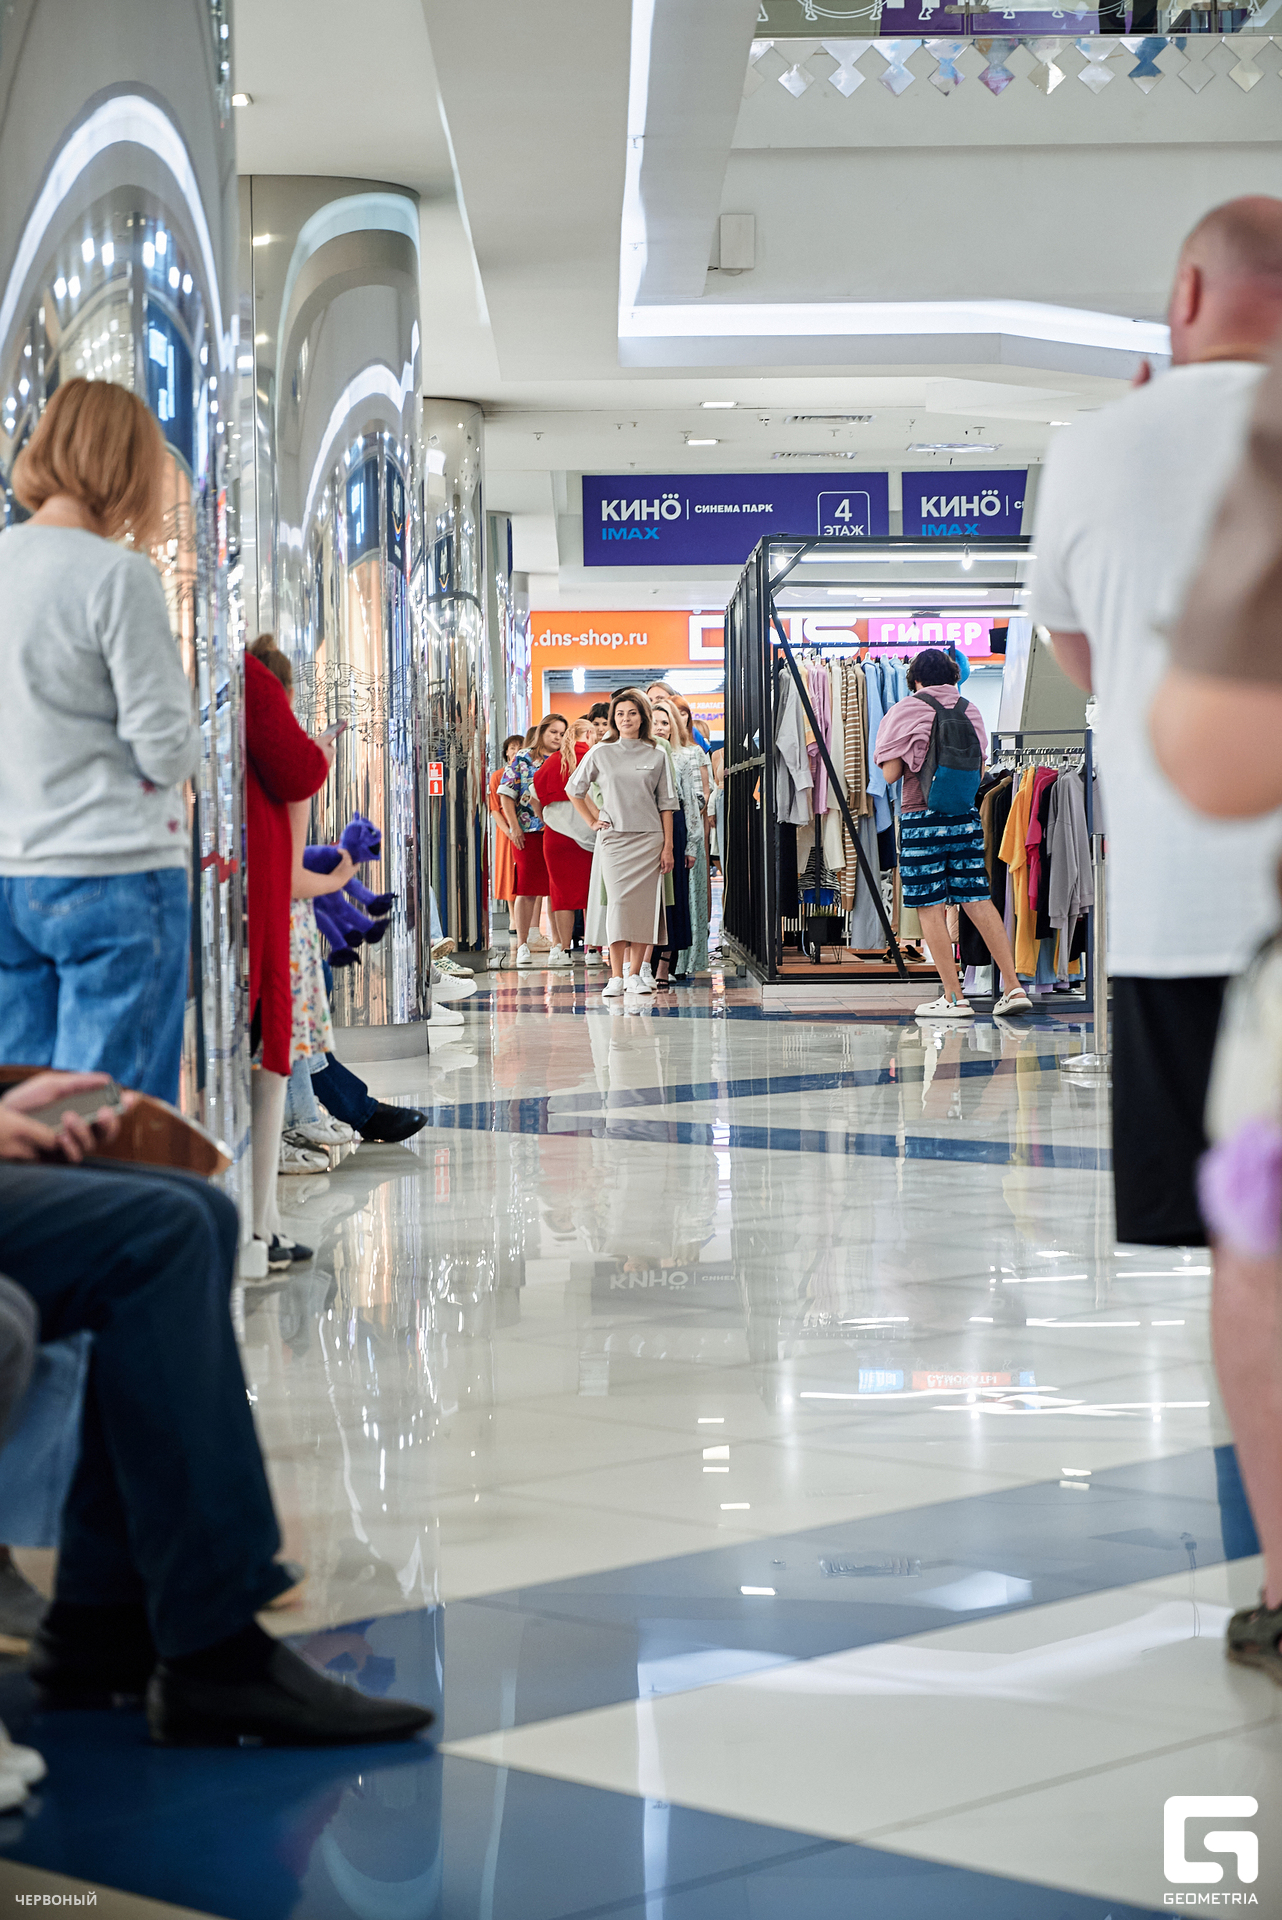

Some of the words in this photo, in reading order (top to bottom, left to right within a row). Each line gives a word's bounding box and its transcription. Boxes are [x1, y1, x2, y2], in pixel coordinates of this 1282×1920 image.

[694, 503, 740, 514] СИНЕМА
[742, 502, 774, 514] ПАРК
[834, 498, 853, 522] 4
[602, 527, 660, 541] IMAX
[823, 524, 865, 537] ЭТАЖ
[921, 523, 979, 537] IMAX
[880, 622, 983, 646] ГИПЕР
